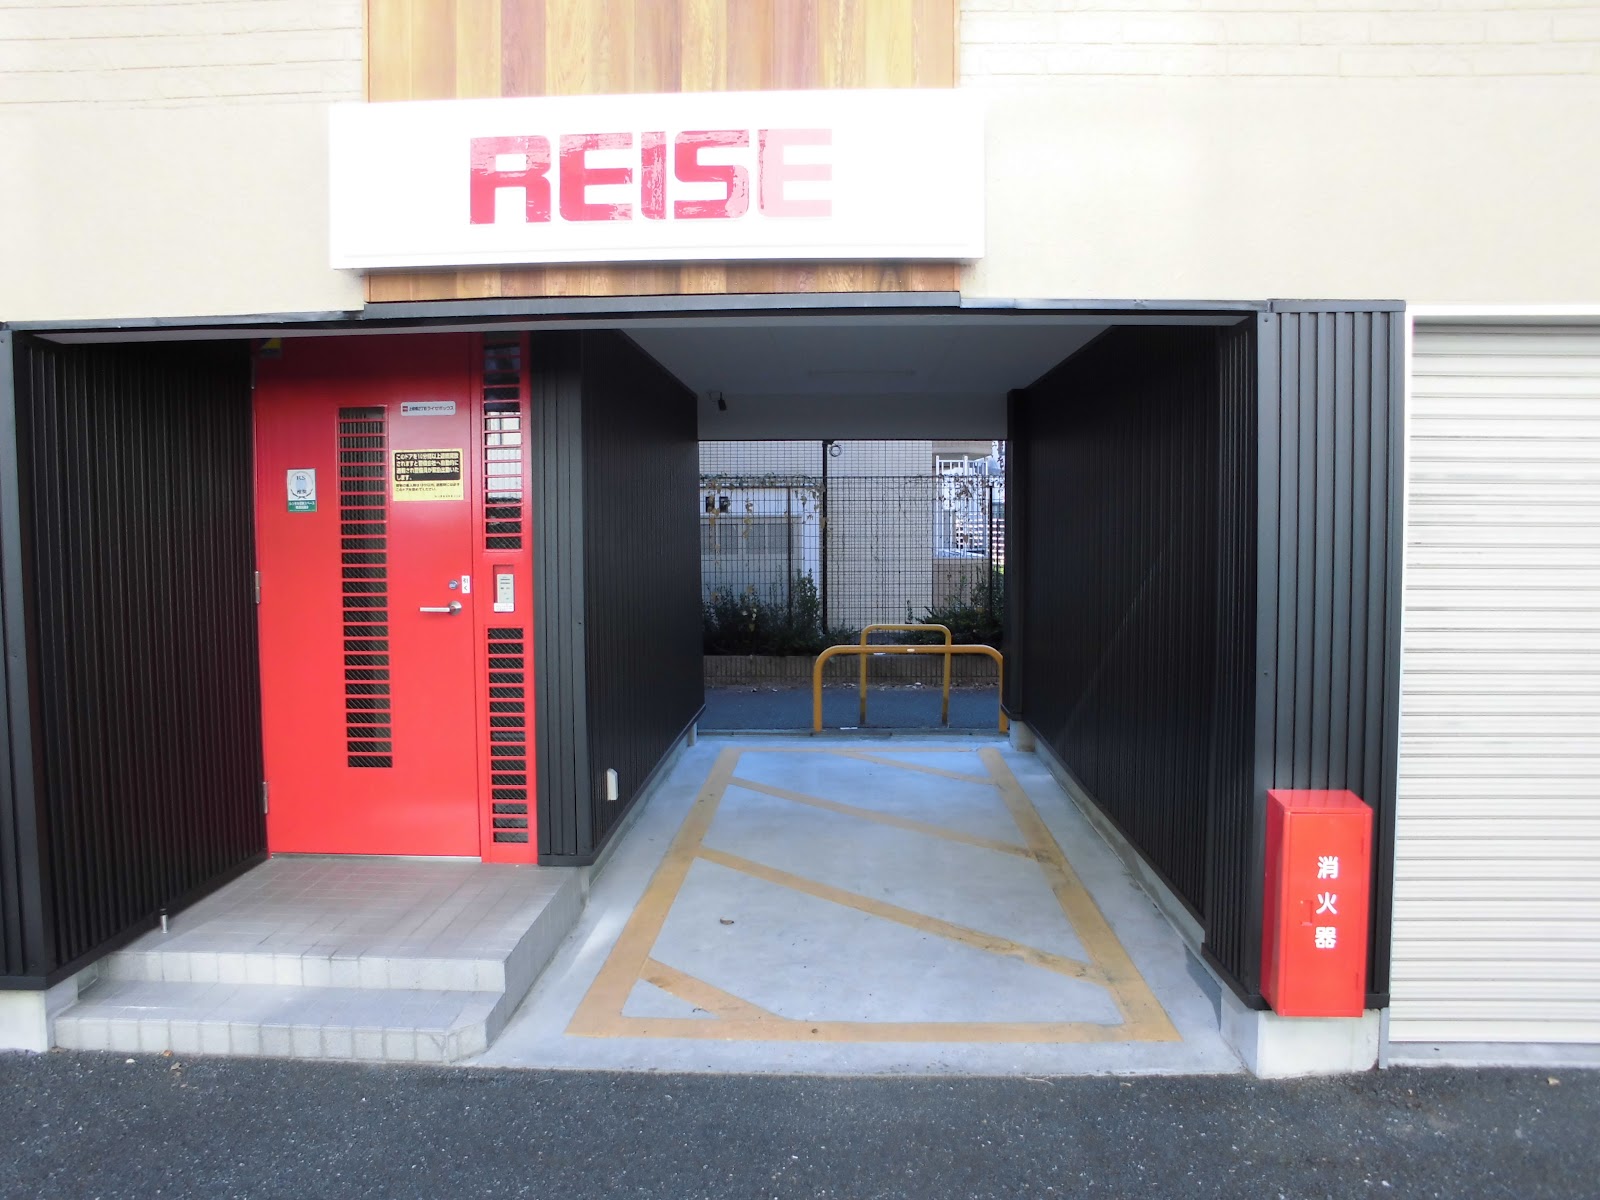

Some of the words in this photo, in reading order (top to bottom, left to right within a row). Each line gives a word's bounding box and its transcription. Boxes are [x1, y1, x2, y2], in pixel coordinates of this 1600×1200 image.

[470, 128, 832, 224] REISE
[463, 577, 469, 591] 引く
[1315, 855, 1339, 949] 消火器
